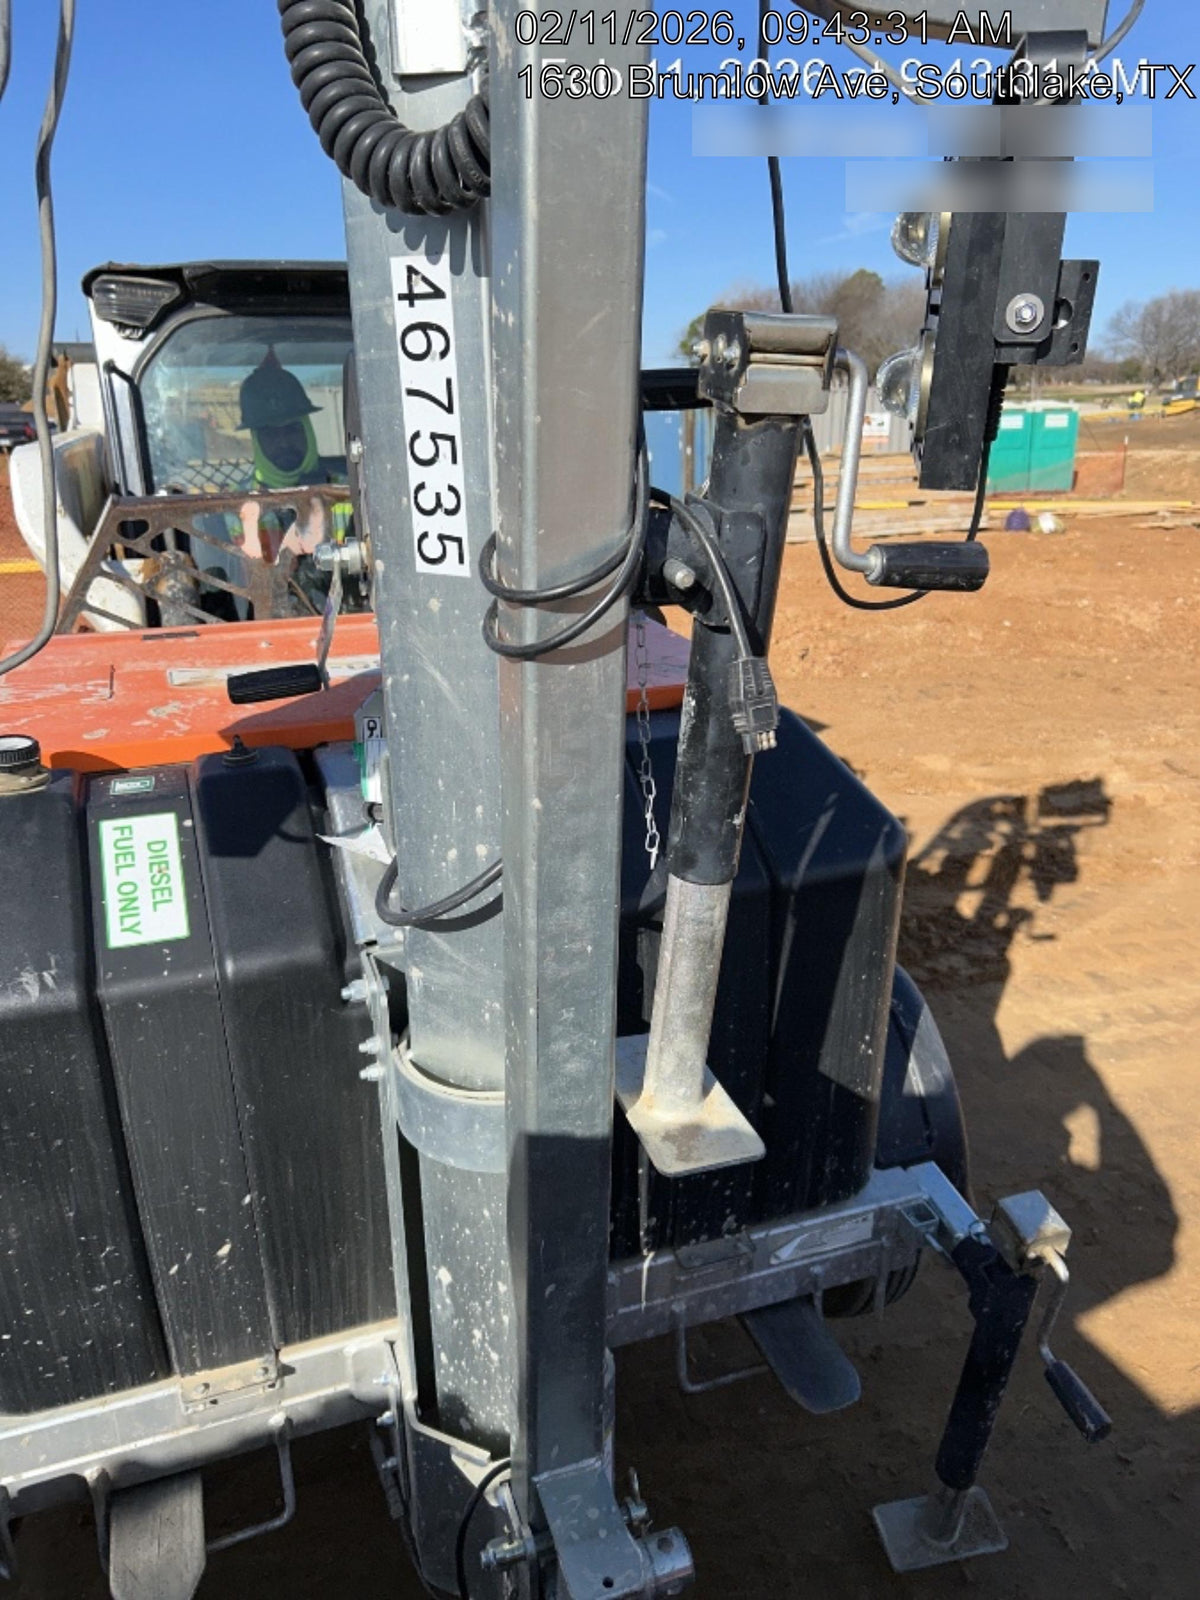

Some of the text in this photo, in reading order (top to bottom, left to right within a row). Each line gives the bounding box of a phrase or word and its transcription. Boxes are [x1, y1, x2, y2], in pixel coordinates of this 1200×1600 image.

[398, 264, 465, 566] 467535
[113, 825, 141, 934] FUEL ONLY
[147, 841, 172, 911] DIESEL
